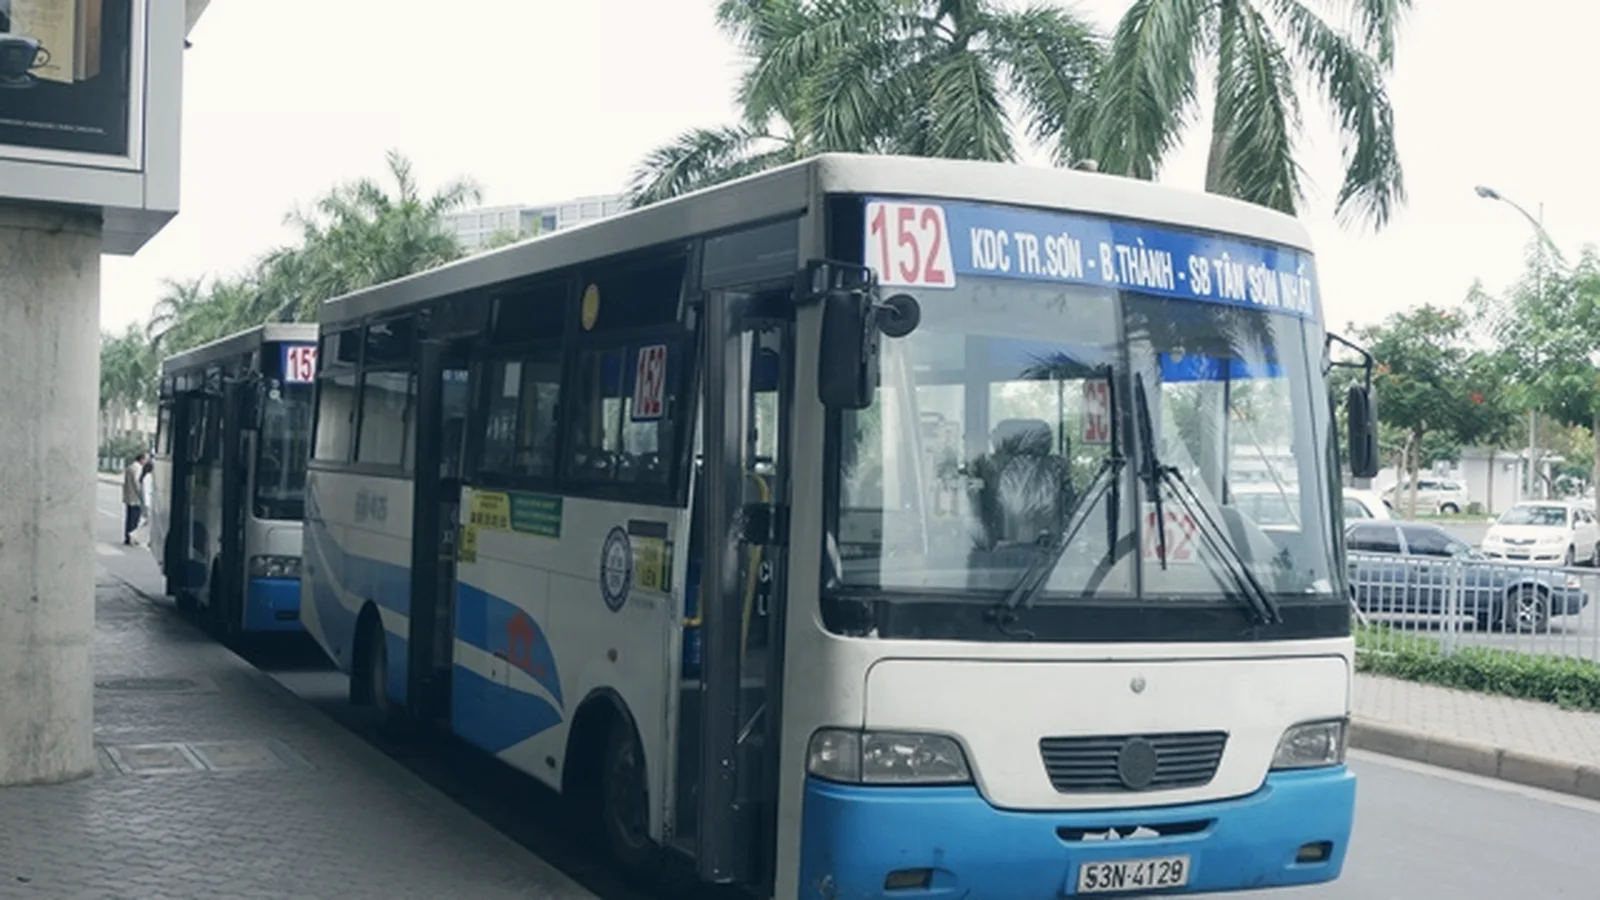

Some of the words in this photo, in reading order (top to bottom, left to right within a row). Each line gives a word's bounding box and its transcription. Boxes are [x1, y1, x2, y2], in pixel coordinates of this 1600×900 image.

[870, 205, 946, 284] 152
[970, 227, 1011, 272] KDC
[1100, 237, 1175, 290] B.THÀNH
[1188, 254, 1211, 296] SB
[1212, 252, 1247, 301] TÂN
[637, 346, 665, 415] 152
